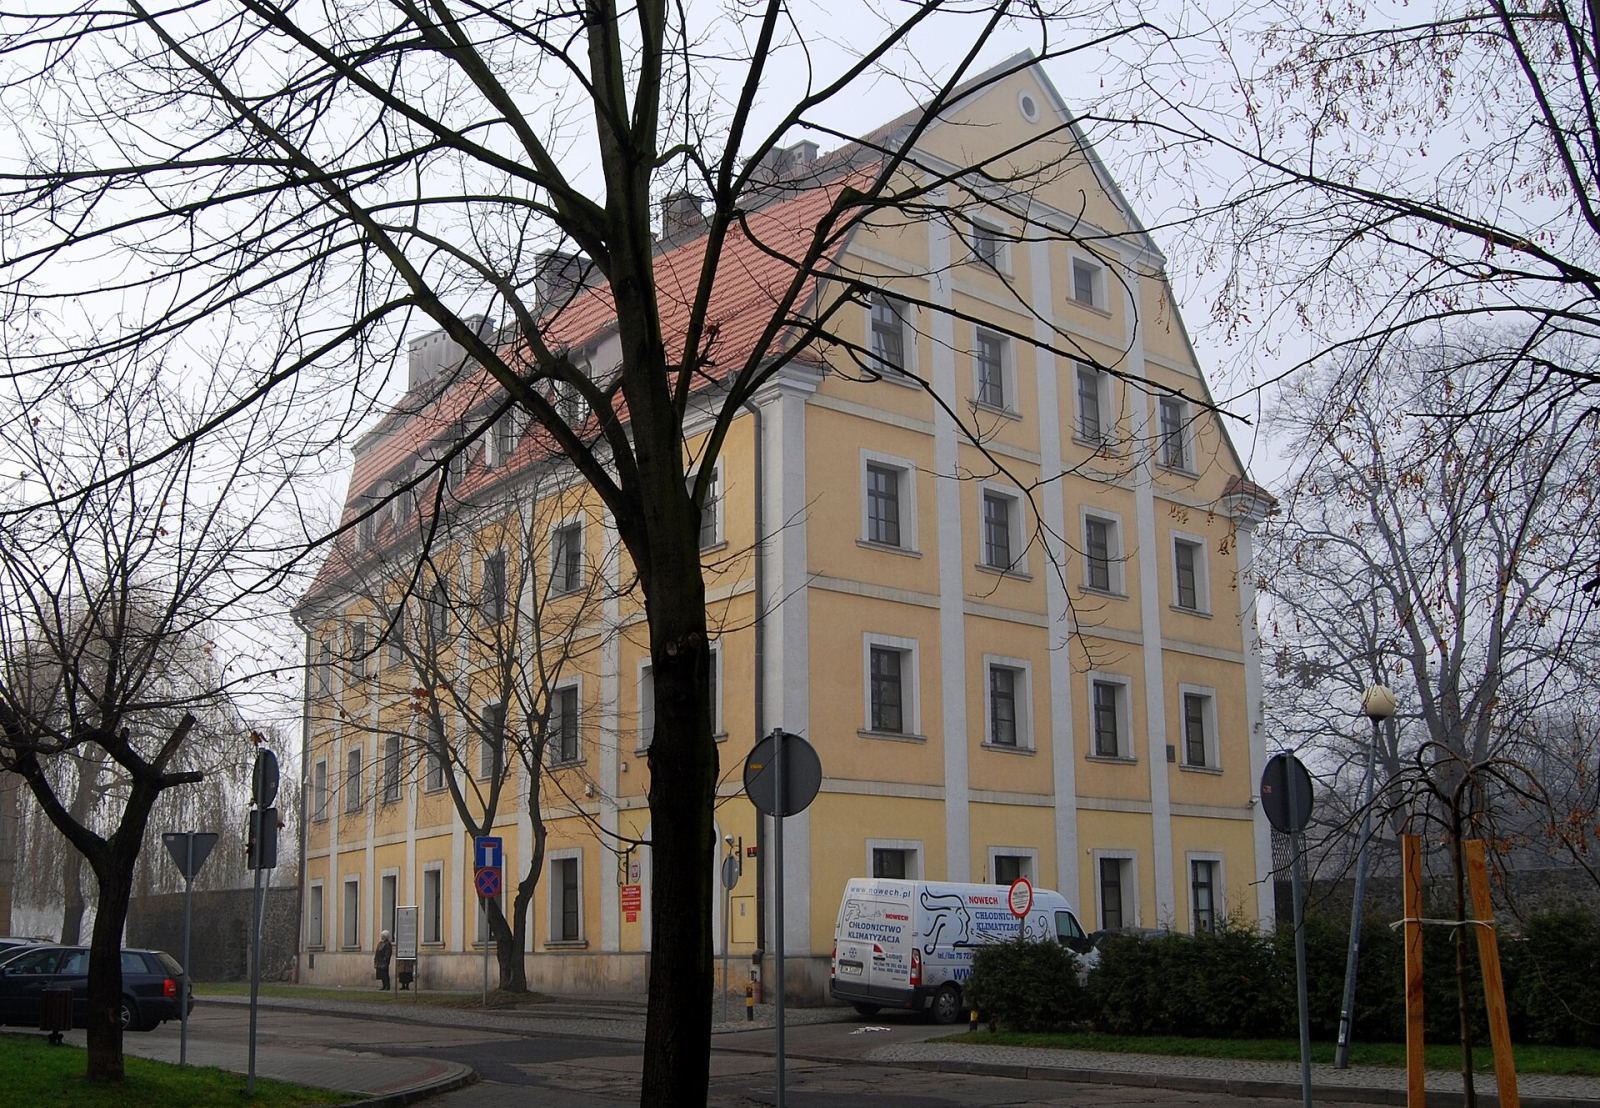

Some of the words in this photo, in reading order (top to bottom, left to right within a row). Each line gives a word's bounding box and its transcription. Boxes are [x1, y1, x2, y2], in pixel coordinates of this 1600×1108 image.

[968, 896, 999, 904] NOWECH
[885, 913, 909, 921] NOWECH
[847, 931, 900, 944] KLIMATYZACJA
